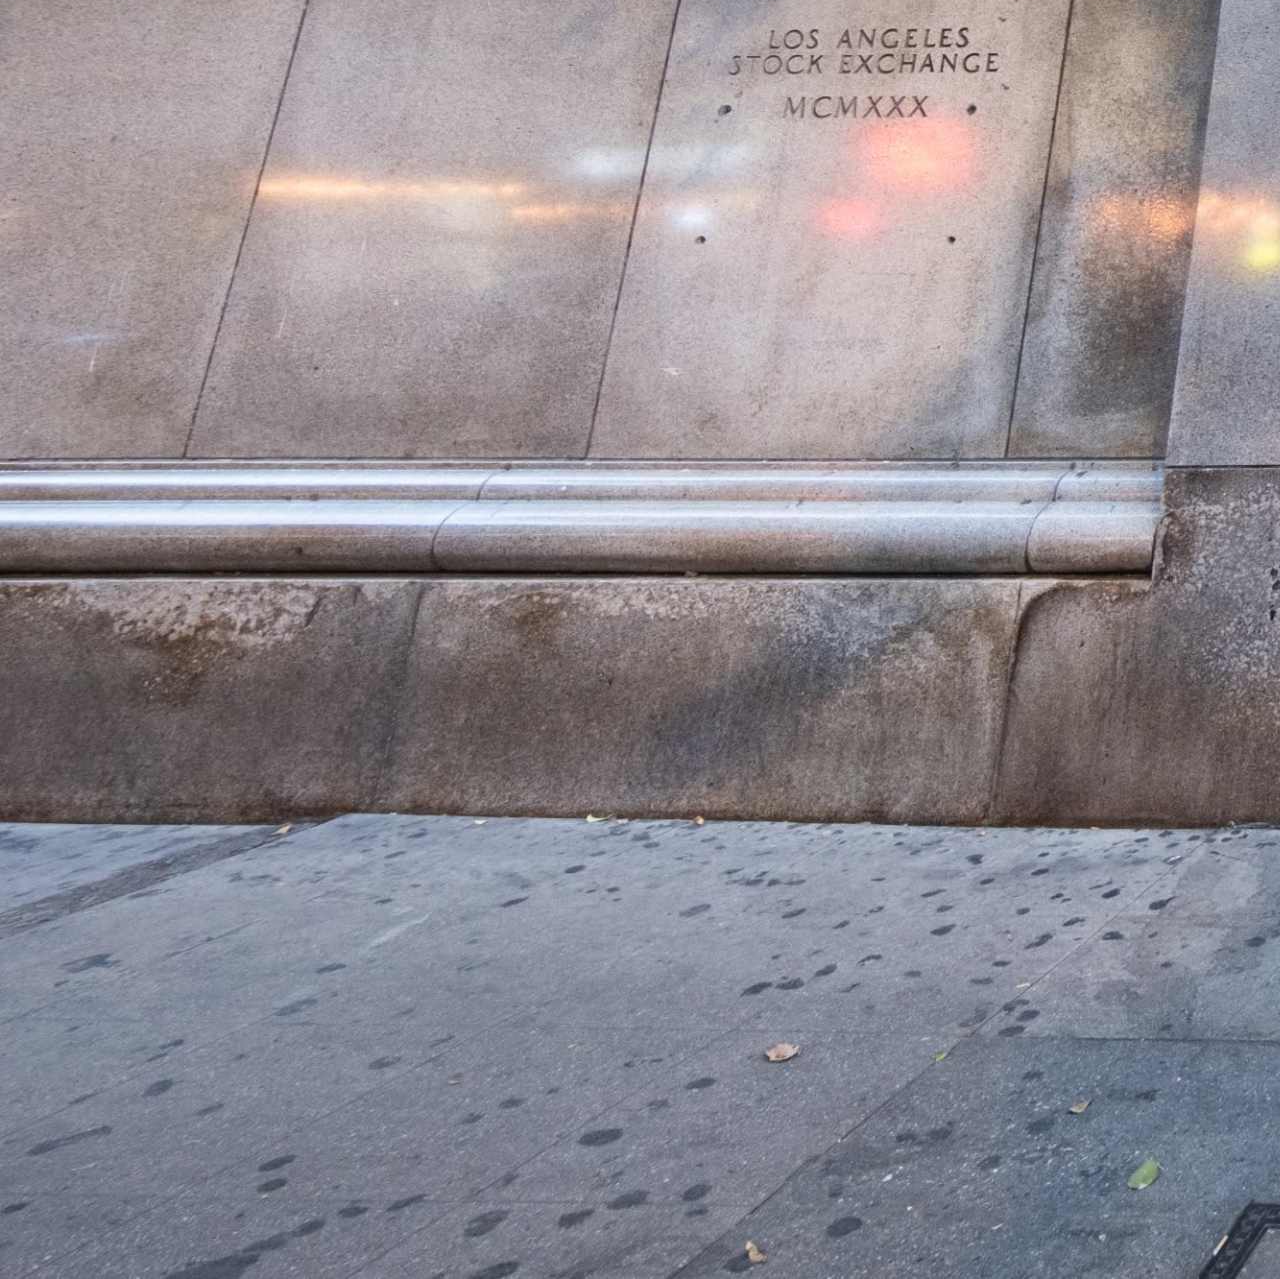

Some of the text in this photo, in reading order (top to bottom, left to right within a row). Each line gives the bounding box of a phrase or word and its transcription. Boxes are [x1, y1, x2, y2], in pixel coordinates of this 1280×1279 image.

[768, 27, 971, 50] LOS ANGELES
[728, 52, 1001, 76] STOCK EXCHANGE
[782, 95, 930, 120] MCMXXX
